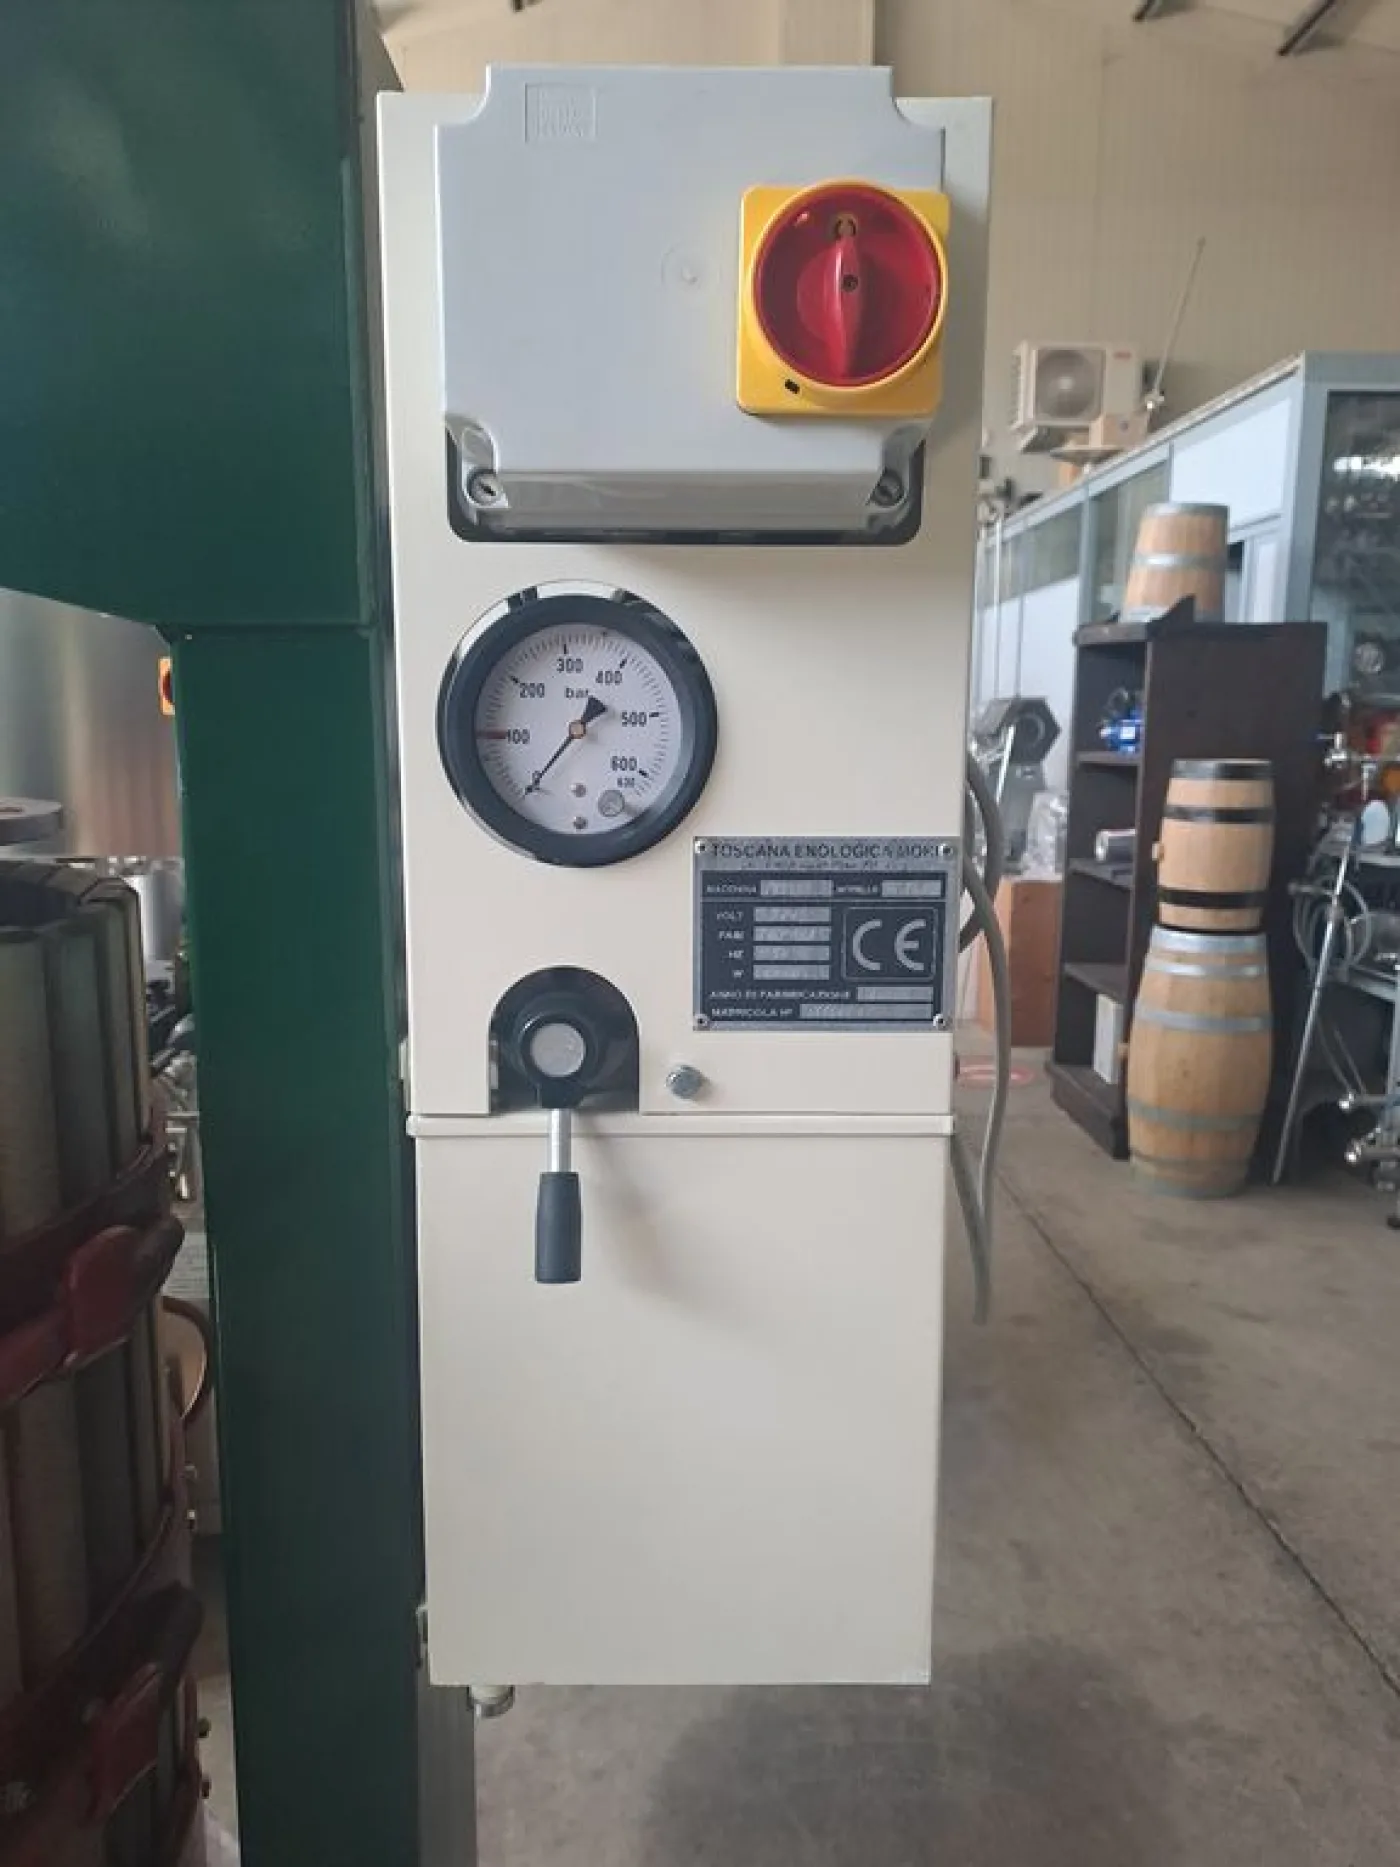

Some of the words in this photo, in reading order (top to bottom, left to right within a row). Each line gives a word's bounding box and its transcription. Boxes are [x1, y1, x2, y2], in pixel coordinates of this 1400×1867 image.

[556, 658, 584, 674] 300
[595, 671, 622, 685] 400
[519, 683, 545, 698] 200
[565, 688, 589, 698] bar
[621, 712, 647, 727] 500
[507, 729, 530, 744] 100
[611, 756, 638, 771] 600
[711, 845, 791, 858] TOSCANA
[794, 844, 893, 858] ENOLOGICA
[852, 919, 927, 971] CE
